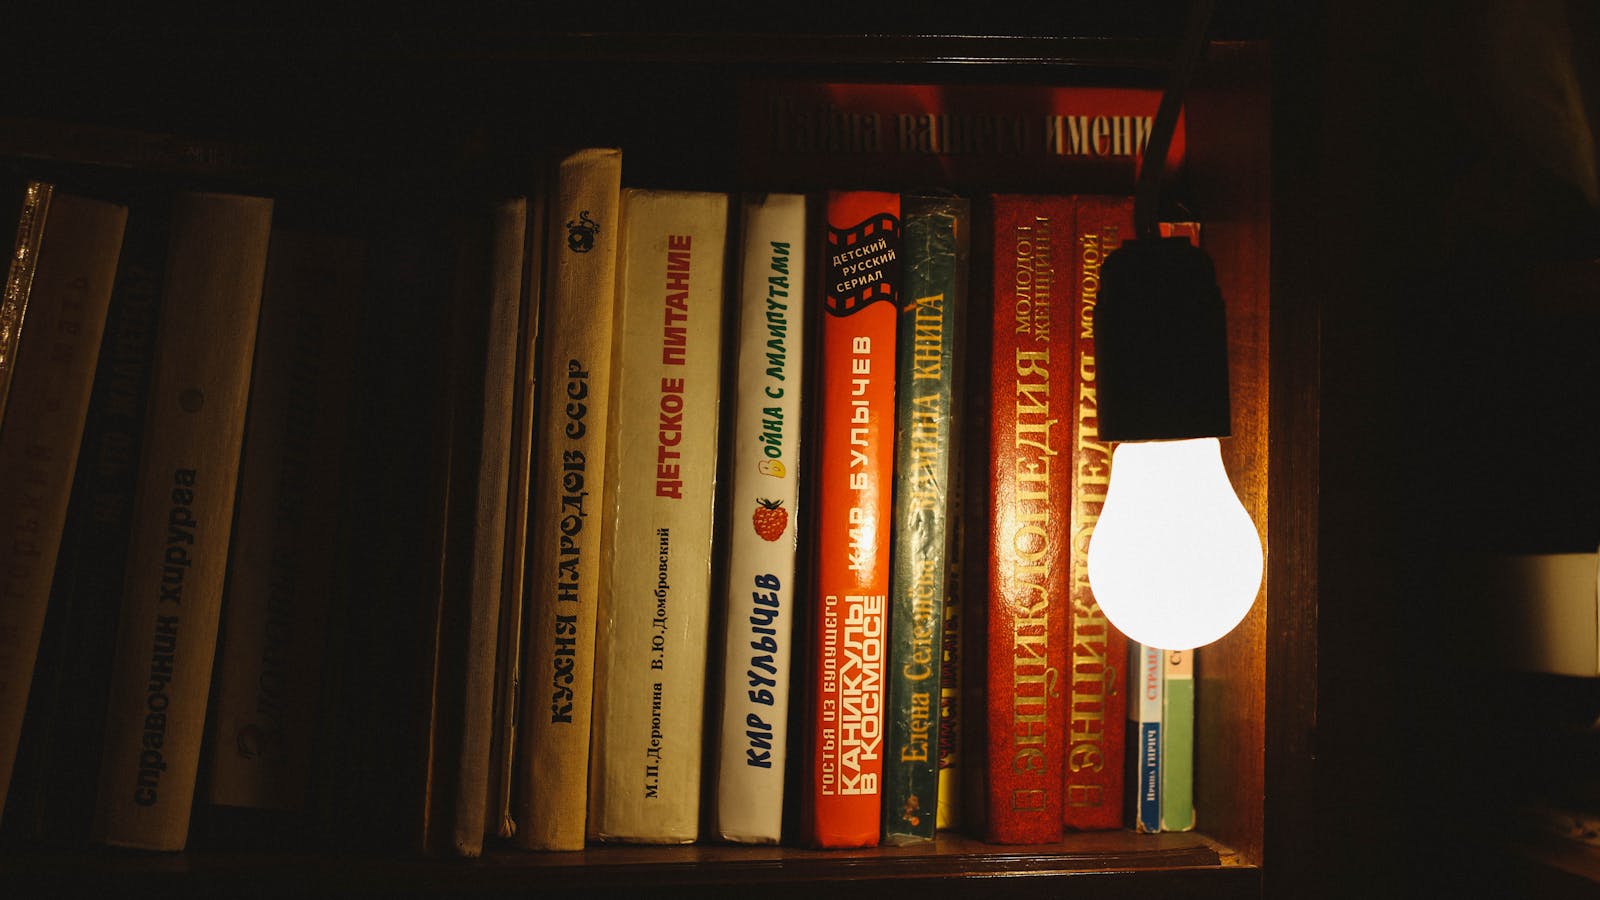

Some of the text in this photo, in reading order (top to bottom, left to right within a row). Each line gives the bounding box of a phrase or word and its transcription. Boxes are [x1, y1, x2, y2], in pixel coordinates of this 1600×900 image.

[766, 241, 790, 380] ЛИЛИПУТАМИ
[833, 238, 887, 267] ДЕТСКИЙ
[836, 270, 883, 293] СЕРИАЛ
[842, 249, 896, 276] РУССКИЙ
[1079, 232, 1101, 339] МОЛОДОЙ
[656, 235, 691, 499] ДЕТСКОЕ ПИТАНИЕ
[849, 336, 872, 570] КИР БУЛЫЧЕВ
[911, 293, 944, 510] МАМИНА КНИГА
[131, 468, 197, 806] справочник хирурга
[550, 359, 589, 723] КУХНЯ НАРОДОВ СССР
[1013, 348, 1059, 775] ЭНЦИКЛОПЕДИЯ
[645, 528, 670, 798] М.П.Дерюгина В.Ю.Домбровский
[745, 573, 780, 768] КИР БУЛЫЧЕВ
[821, 595, 838, 796] ГОСТЬЯ ИЗ БУДУЩЕГО
[839, 596, 864, 796] КАНИКУЛЫ
[860, 596, 884, 795] В КОСМОСЕ
[902, 692, 931, 762] Елена
[1146, 729, 1156, 767] ГИРИЧ
